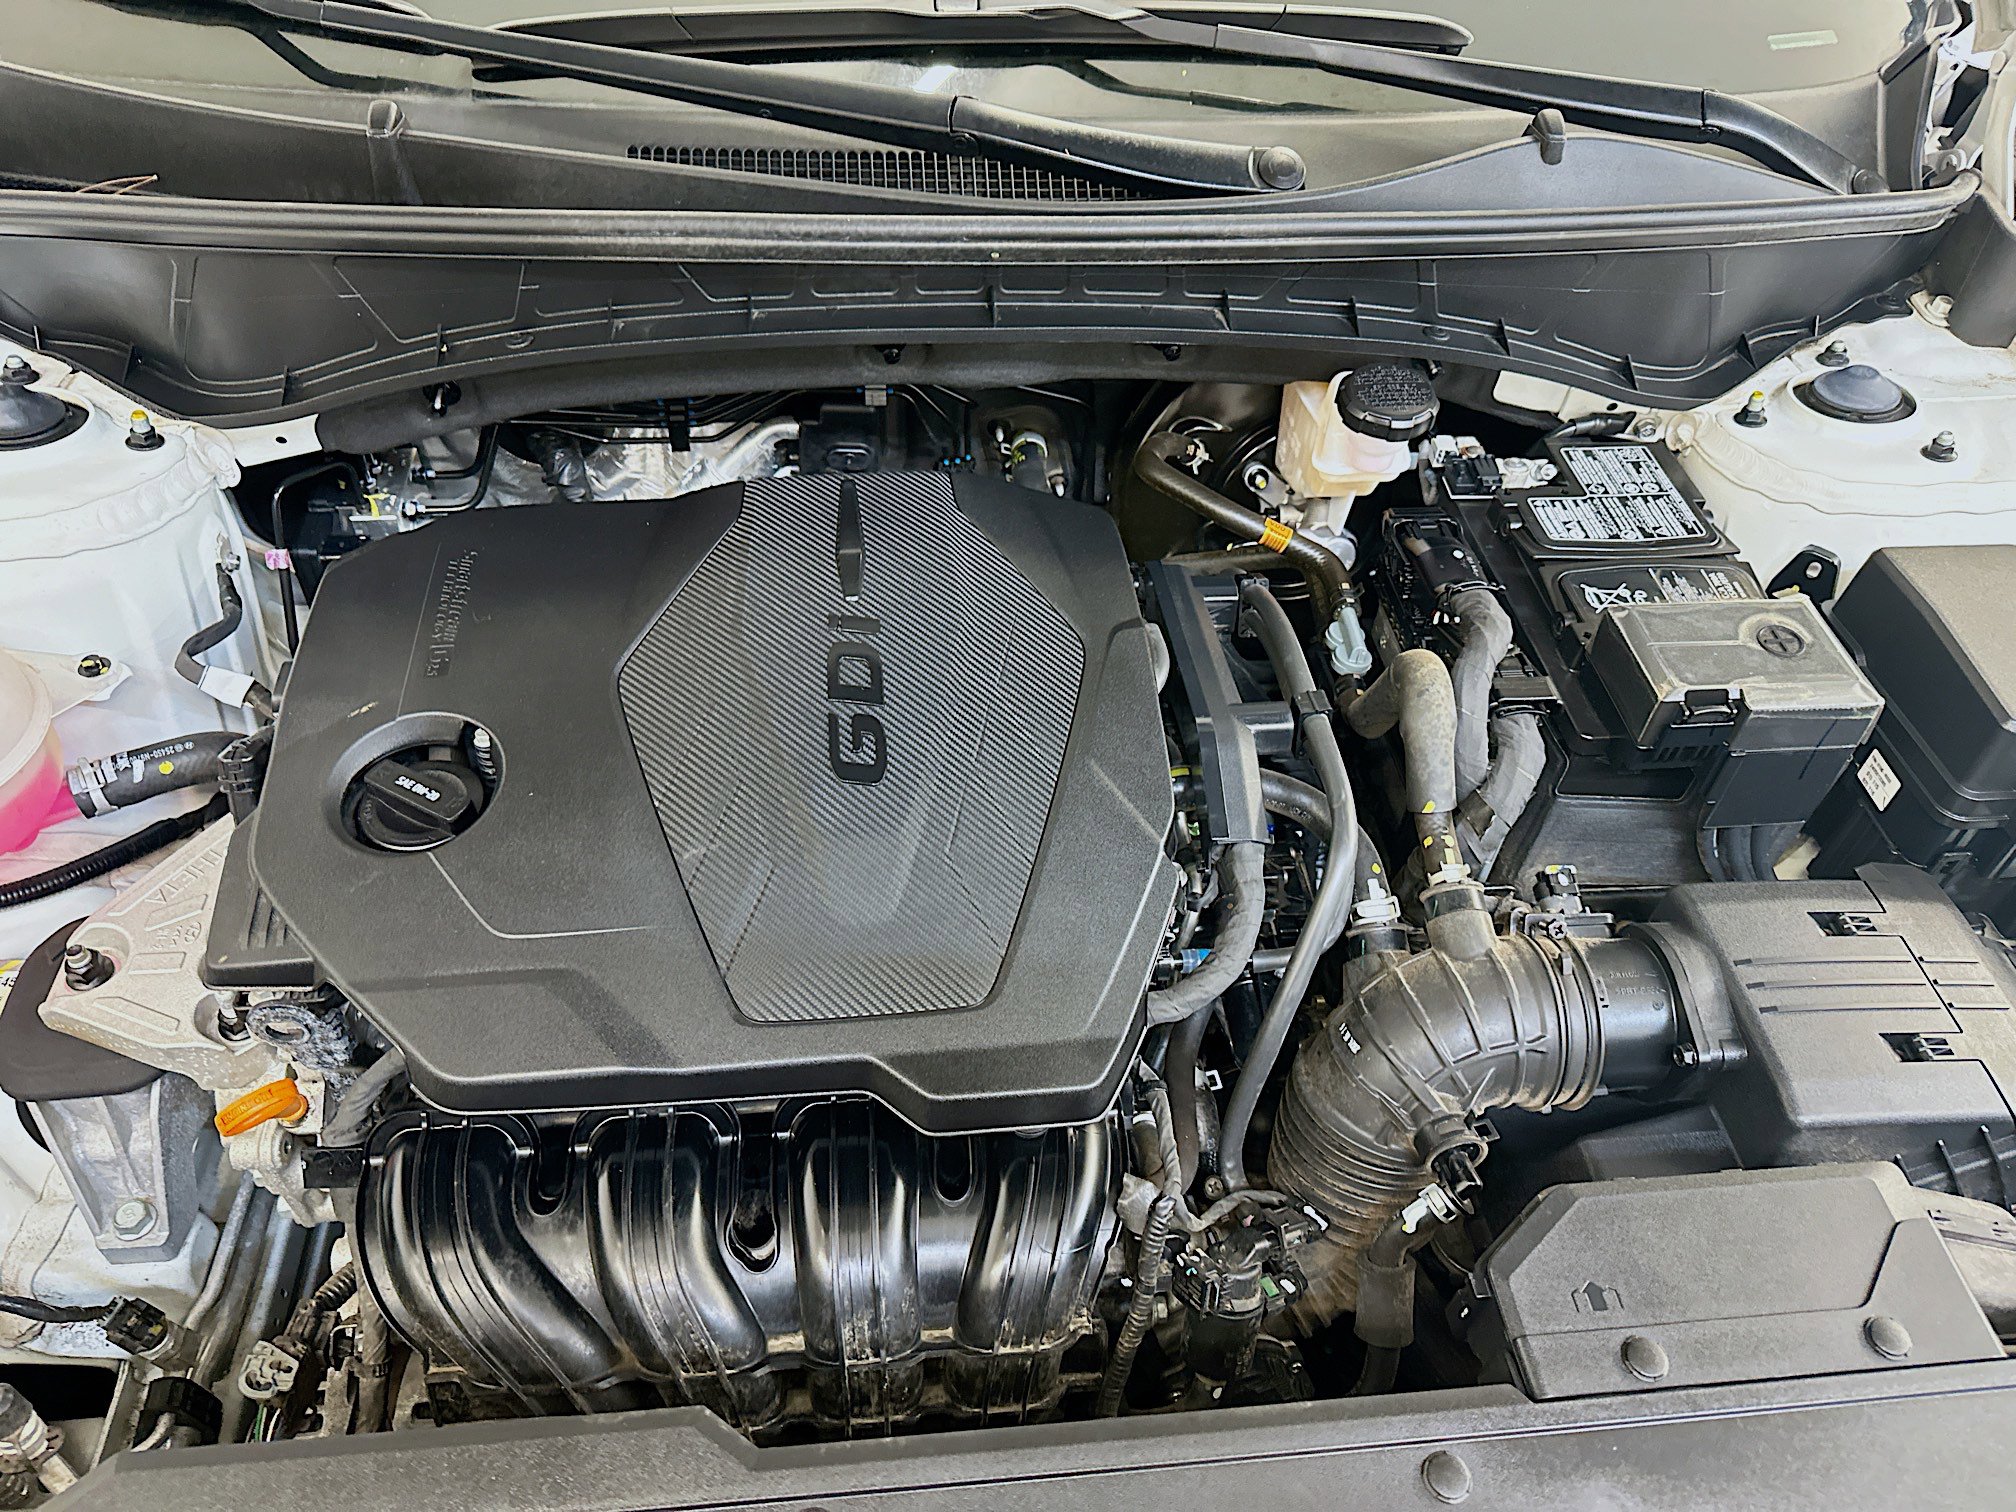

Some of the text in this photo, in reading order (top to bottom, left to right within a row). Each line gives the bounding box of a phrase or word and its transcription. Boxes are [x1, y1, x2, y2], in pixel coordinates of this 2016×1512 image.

[394, 774, 440, 802] SAE 0W-20
[145, 849, 222, 904] THETA
